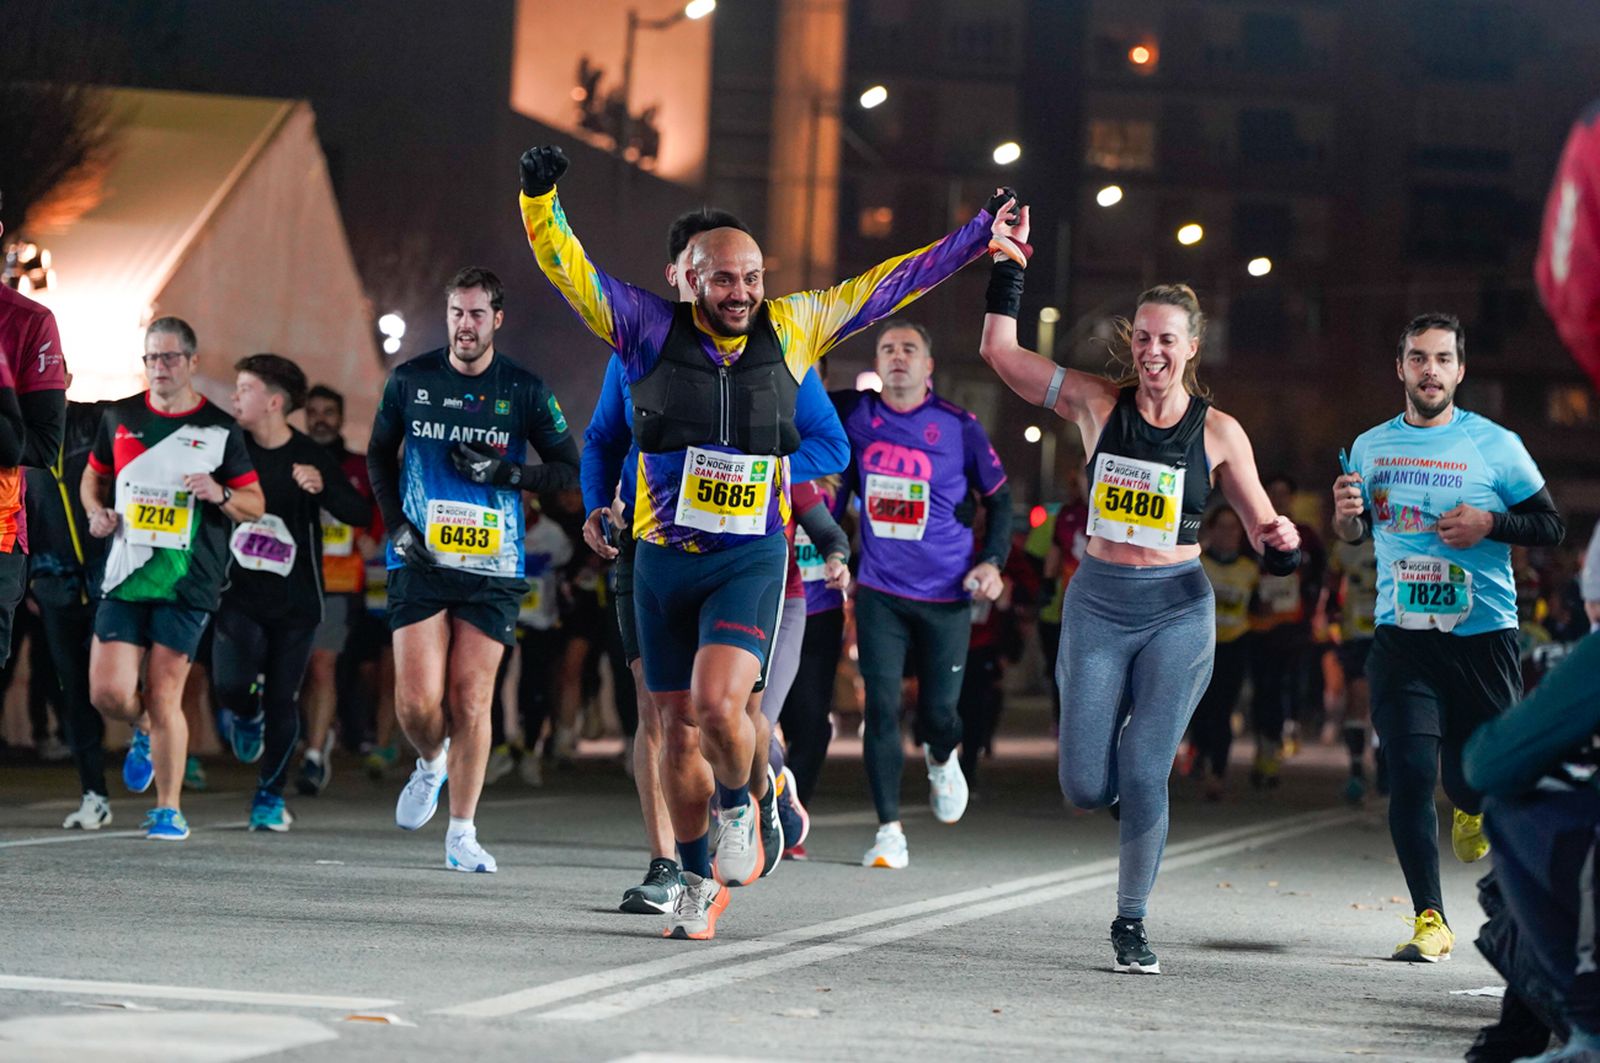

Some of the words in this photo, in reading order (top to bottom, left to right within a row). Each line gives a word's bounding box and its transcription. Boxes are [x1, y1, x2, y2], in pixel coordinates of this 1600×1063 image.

[412, 420, 445, 440] SAN
[450, 425, 510, 447] ANTÓN
[706, 460, 733, 472] NOCHE
[735, 464, 745, 472] DE
[1374, 456, 1467, 471] VILLARDOMPARDO
[695, 467, 712, 478] SAN
[1103, 474, 1119, 485] SAN
[1114, 467, 1138, 478] NOCHE
[1140, 472, 1151, 480] DE
[1373, 470, 1391, 485] SAN
[1393, 469, 1429, 486] ANTÓN
[1432, 473, 1463, 488] 2026
[697, 479, 756, 508] 5685
[1105, 486, 1165, 519] 5480
[138, 505, 176, 526] 7214
[446, 509, 467, 517] NOCHE
[440, 525, 489, 548] 6433
[1401, 572, 1415, 580] SAN
[1407, 583, 1456, 606] 7823
